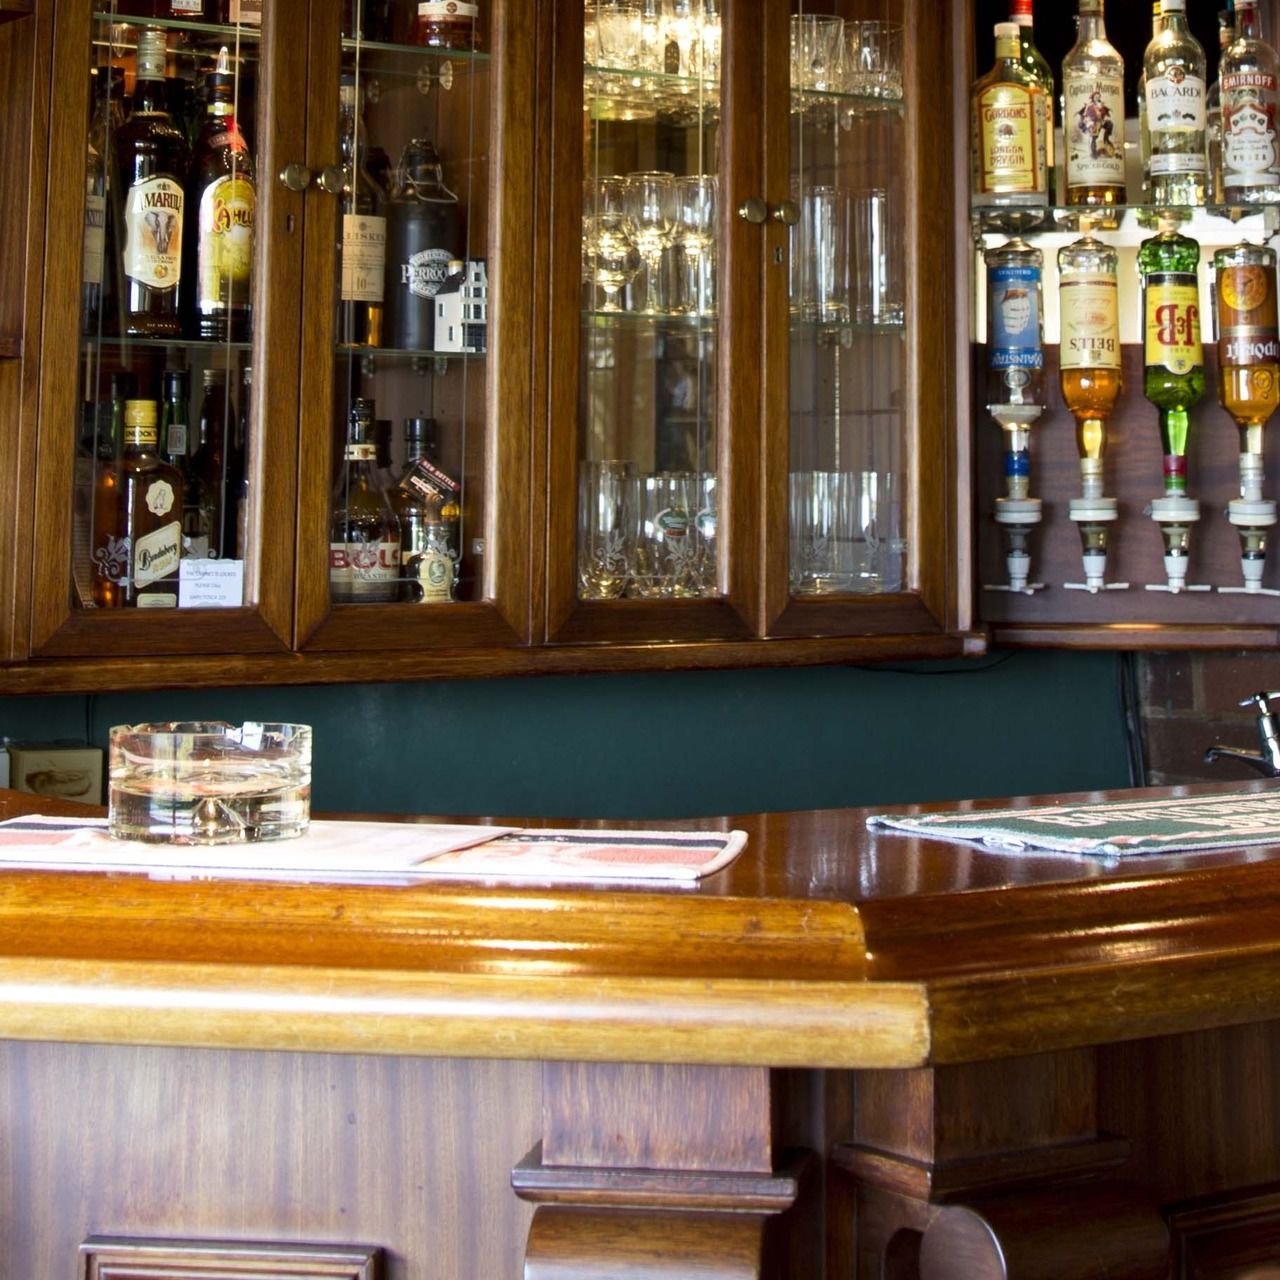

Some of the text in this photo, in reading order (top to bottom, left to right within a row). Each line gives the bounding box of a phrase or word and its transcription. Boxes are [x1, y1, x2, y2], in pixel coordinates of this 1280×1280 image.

[1223, 75, 1273, 90] SMIRNOFF
[1151, 87, 1201, 99] BACARDI
[1155, 303, 1198, 347] J&B
[1070, 338, 1115, 352] BELL'S
[328, 549, 401, 569] BOLS
